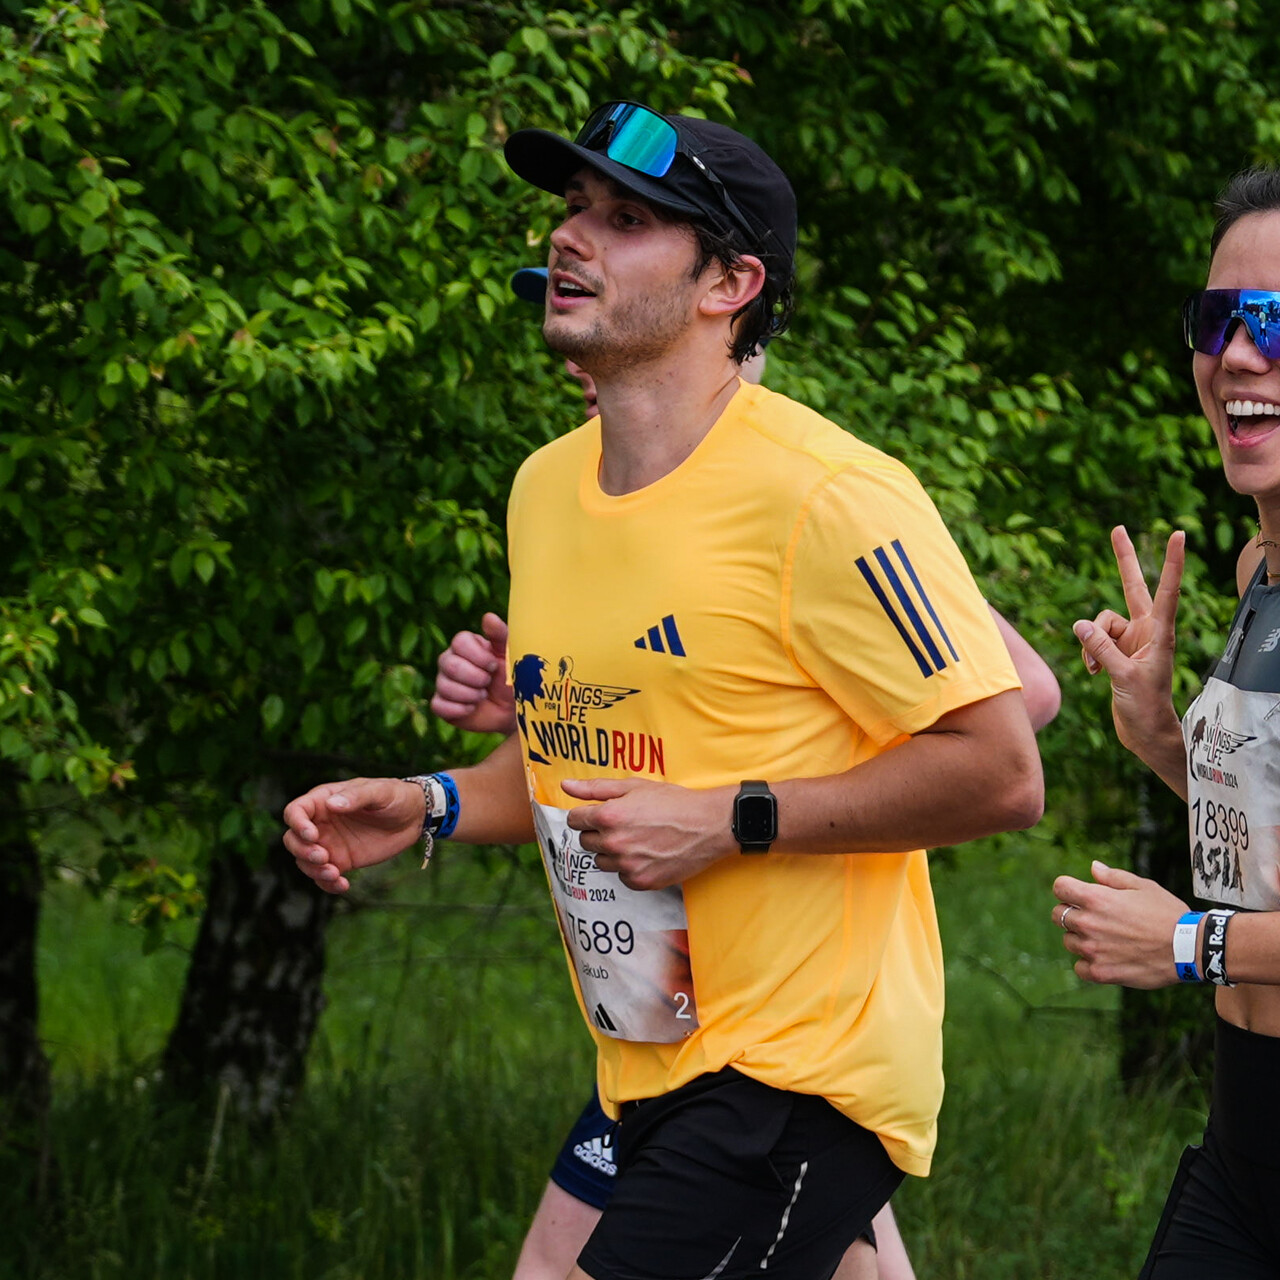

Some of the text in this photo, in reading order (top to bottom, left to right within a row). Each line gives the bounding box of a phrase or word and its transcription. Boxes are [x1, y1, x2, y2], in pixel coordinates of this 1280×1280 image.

[544, 680, 603, 706] WINGS
[544, 701, 556, 710] FOR
[557, 702, 588, 724] LIFE
[531, 720, 665, 777] WORLD RUN
[1207, 725, 1232, 751] WINGS
[1207, 747, 1223, 767] LIFE
[1223, 771, 1239, 790] 2024
[1192, 797, 1249, 850] 18399
[563, 868, 587, 886] LIFE
[571, 886, 588, 901] RUN
[588, 888, 616, 902] 2024
[673, 992, 692, 1019] 2
[573, 1144, 618, 1176] adidas
